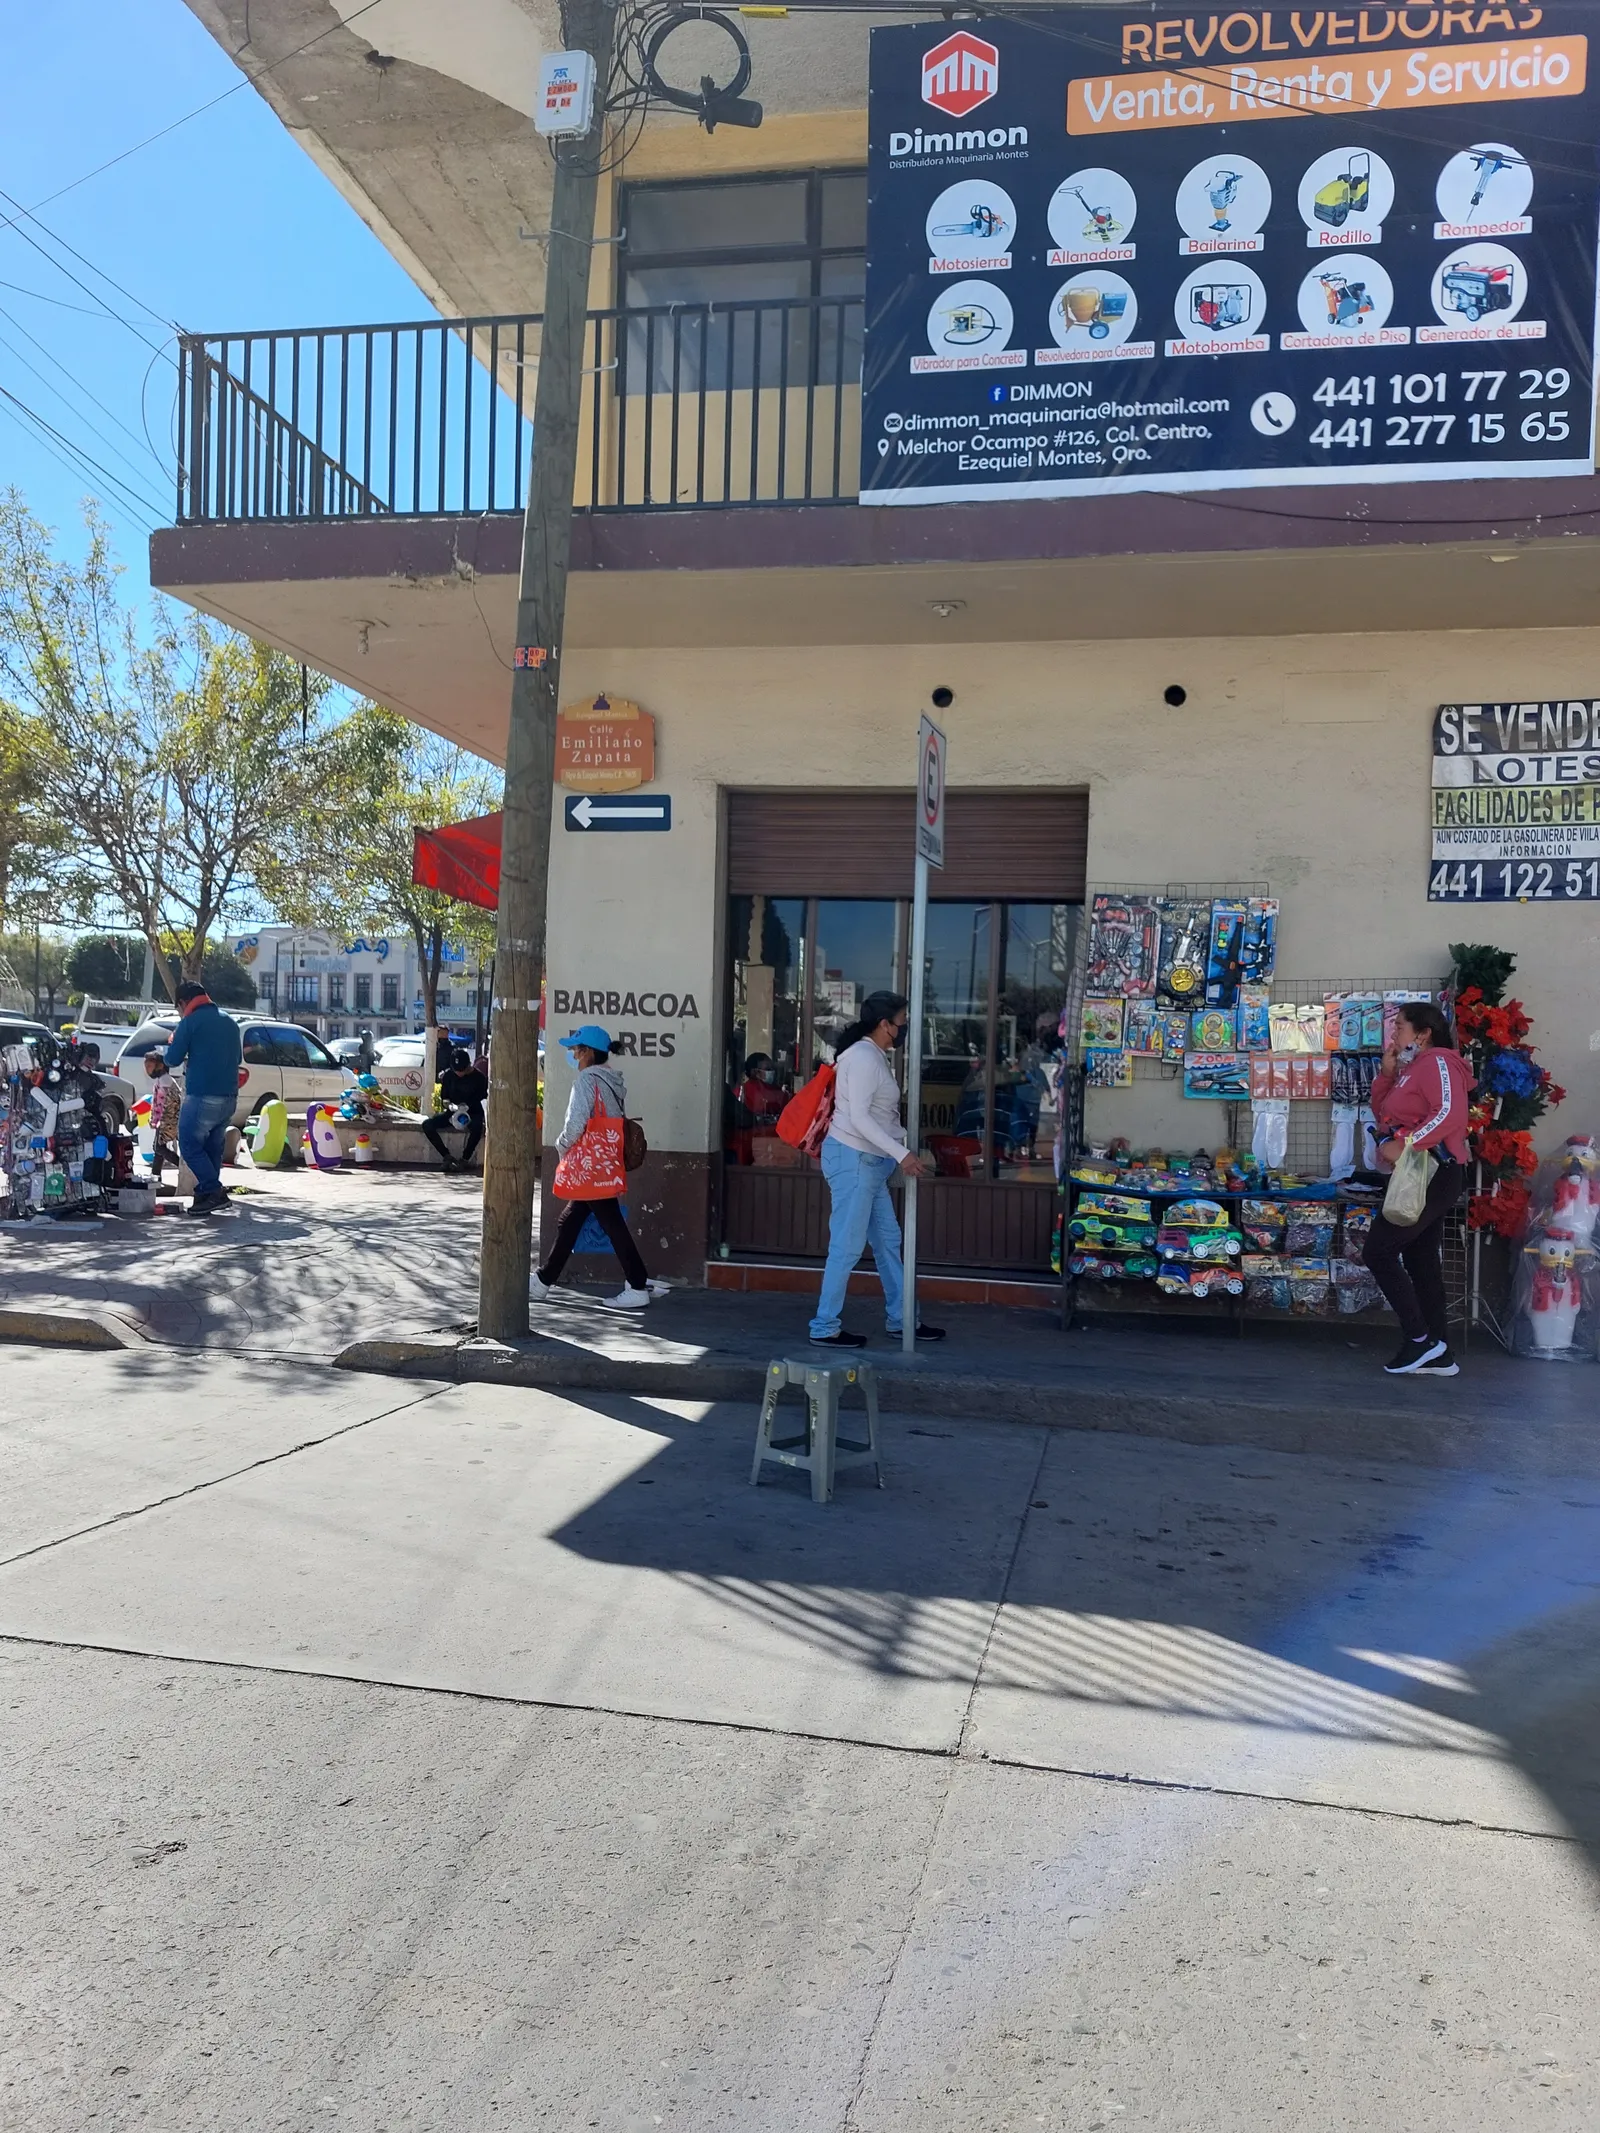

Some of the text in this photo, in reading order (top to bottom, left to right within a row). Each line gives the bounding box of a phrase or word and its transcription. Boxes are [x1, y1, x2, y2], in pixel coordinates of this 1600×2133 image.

[1121, 0, 1543, 64] REVOLVEDORAS
[1084, 45, 1570, 123] Venta, Renta y Servicio
[889, 126, 1029, 156] Dimmon
[889, 150, 1029, 170] Distribuidora Maquinaria Montes
[1319, 231, 1372, 245] Rodillo
[1439, 220, 1526, 238] Rompedor
[1188, 238, 1257, 253] Bailarina
[933, 256, 1009, 271] Motosierra
[1050, 249, 1133, 265] Allanadora
[1284, 329, 1407, 349] Cortadora de Piso
[1419, 324, 1543, 342] Generador de Luz
[1037, 344, 1153, 363] Revolvedora para Concreto
[1171, 339, 1265, 355] Motobomba
[913, 353, 1024, 371] Vibrador para Concreto
[1010, 381, 1092, 402] DIMMON
[1312, 367, 1571, 407] 441 101 77 29
[904, 398, 1230, 431] dimmon_maquinaria@hotmail.com
[897, 420, 1213, 456] Melchor Ocampo #126, Col. Centro,
[1309, 410, 1571, 449] 441 277 15 65
[958, 445, 1152, 472] Ezequiel Montes, Qro.
[589, 725, 614, 734] Calle
[1440, 701, 1600, 754] SE VENDE
[562, 735, 642, 749] Emiliano
[572, 750, 631, 766] Zapata
[1473, 755, 1600, 784] LOTES
[1435, 789, 1554, 824] FACILIDADES
[1561, 788, 1585, 822] DE
[1453, 830, 1489, 843] COSTADO
[1490, 829, 1501, 843] DE
[1503, 829, 1512, 843] LA
[1514, 828, 1564, 843] GASOLINERA
[1567, 828, 1577, 841] DE
[1500, 844, 1572, 857] INFORMACION
[1431, 861, 1599, 898] 441 122 51
[554, 989, 700, 1019] BARBACOA
[1193, 1054, 1236, 1065] ZOOM
